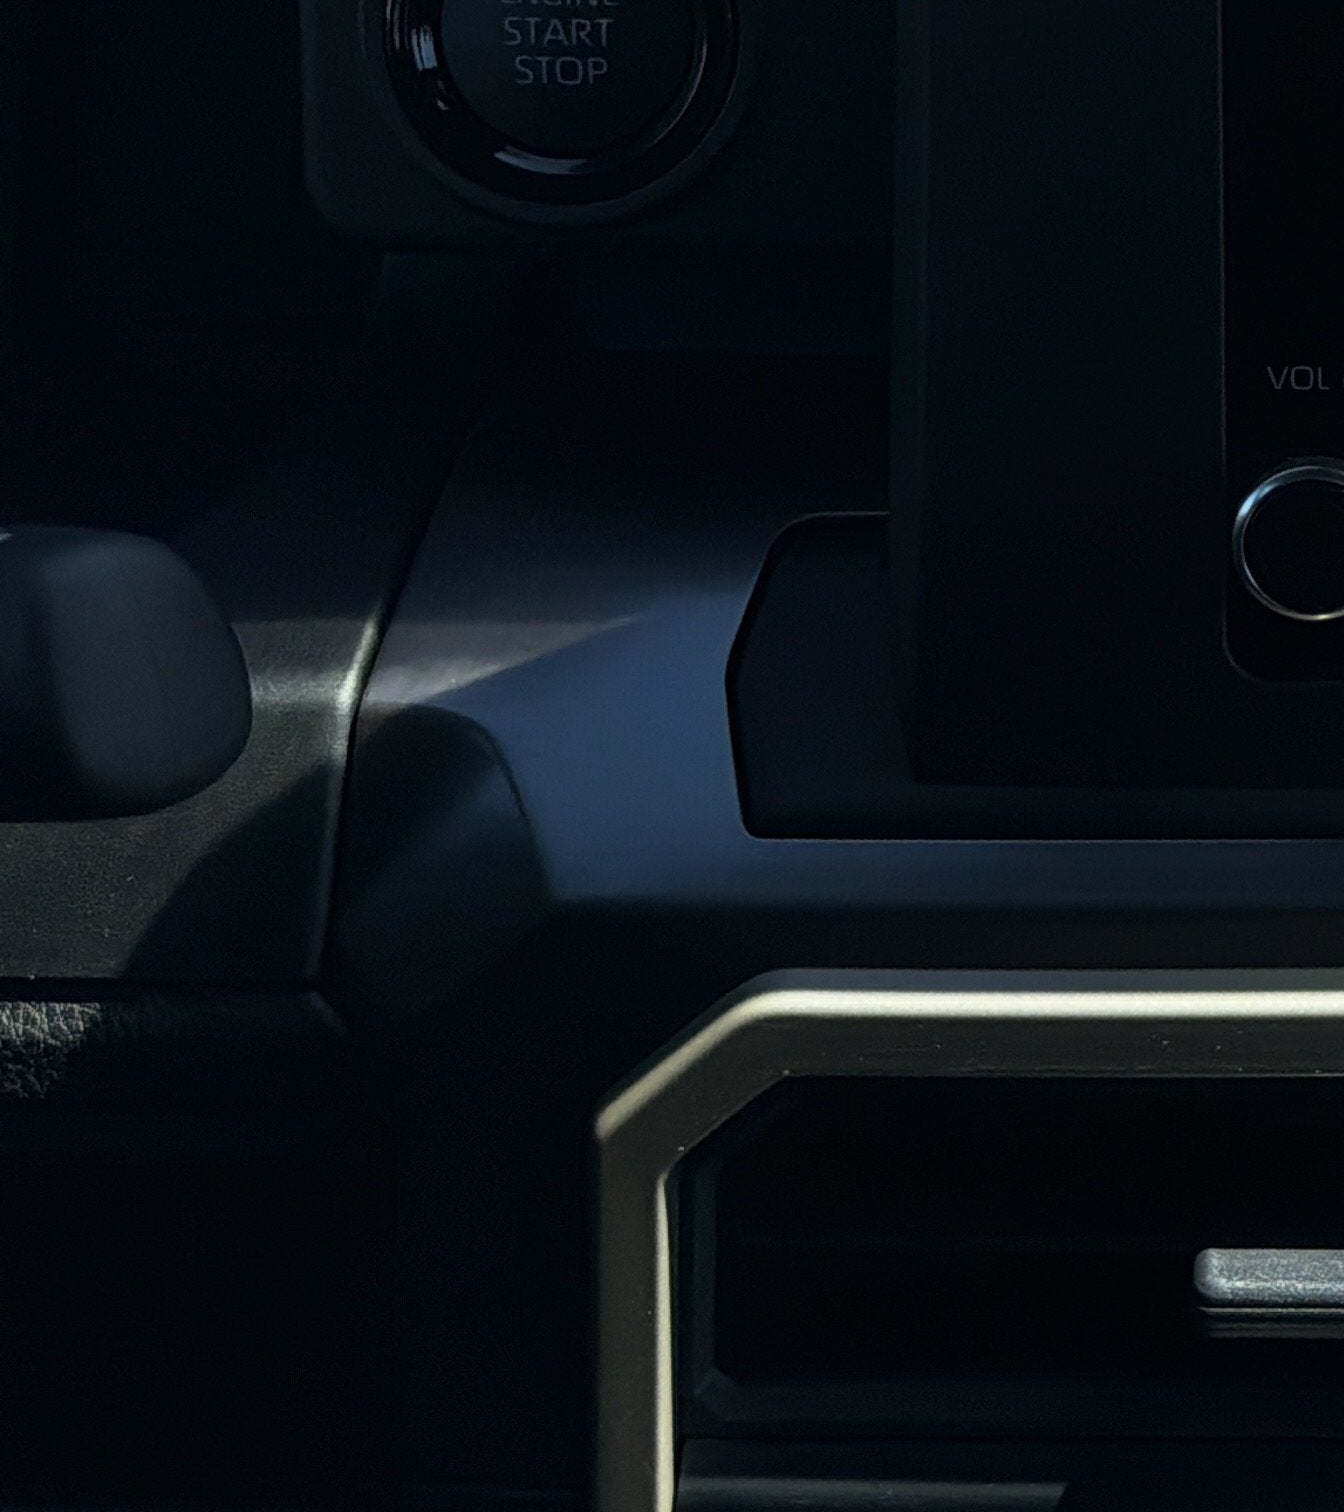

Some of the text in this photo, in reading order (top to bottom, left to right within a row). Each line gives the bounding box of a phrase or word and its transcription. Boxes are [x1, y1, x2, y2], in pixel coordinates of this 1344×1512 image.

[503, 16, 615, 47] START
[513, 55, 609, 85] STOP
[1266, 364, 1330, 390] VOL
